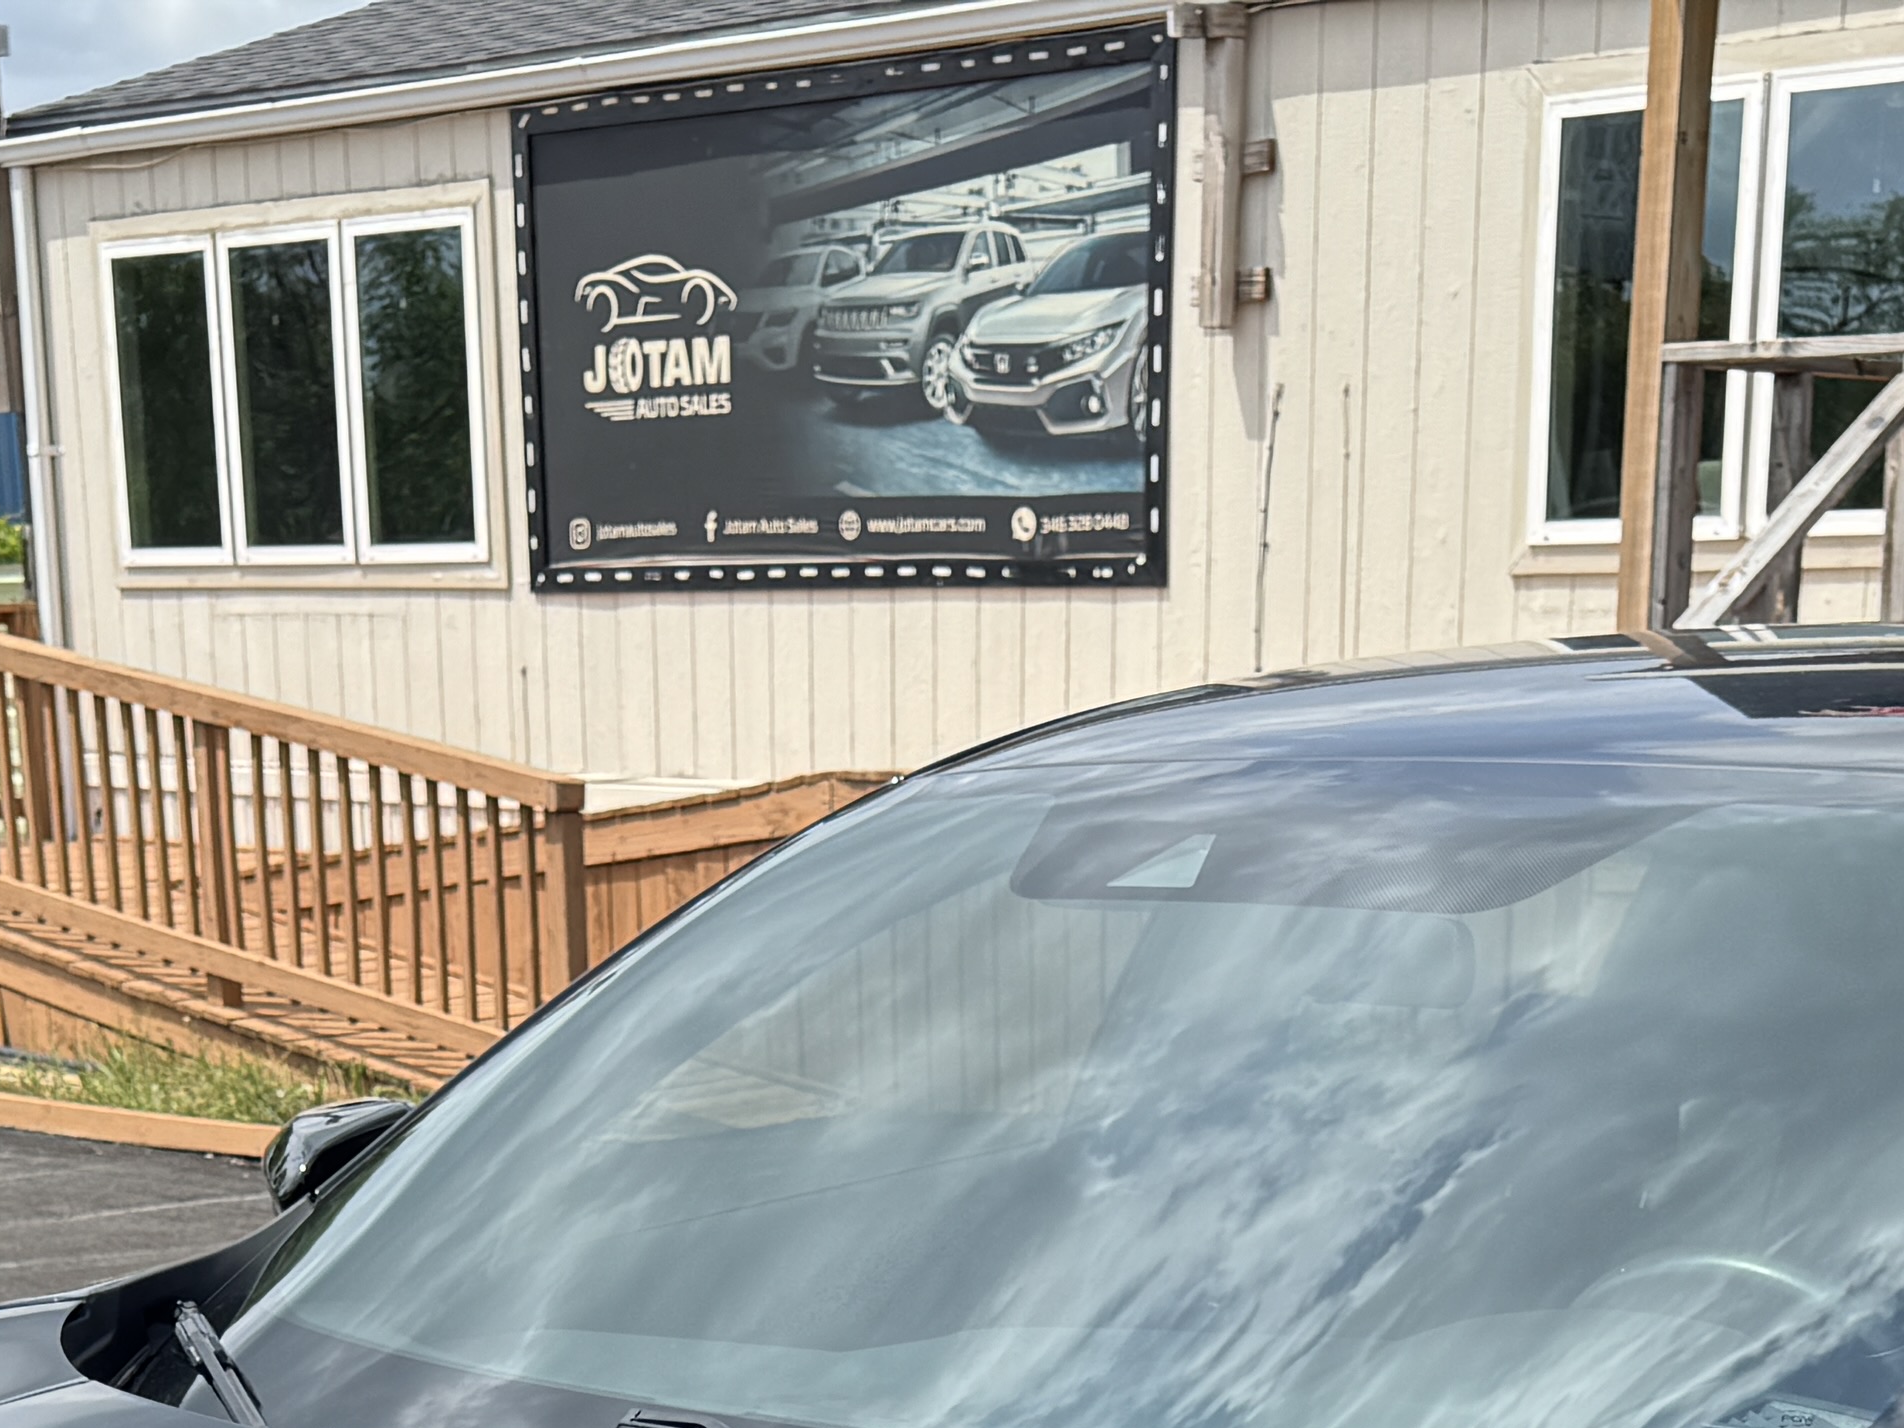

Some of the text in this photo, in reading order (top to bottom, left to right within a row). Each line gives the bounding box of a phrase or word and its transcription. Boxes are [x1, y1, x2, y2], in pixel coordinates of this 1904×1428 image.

[583, 334, 731, 394] JOTAM
[635, 392, 732, 420] AUTO SALES
